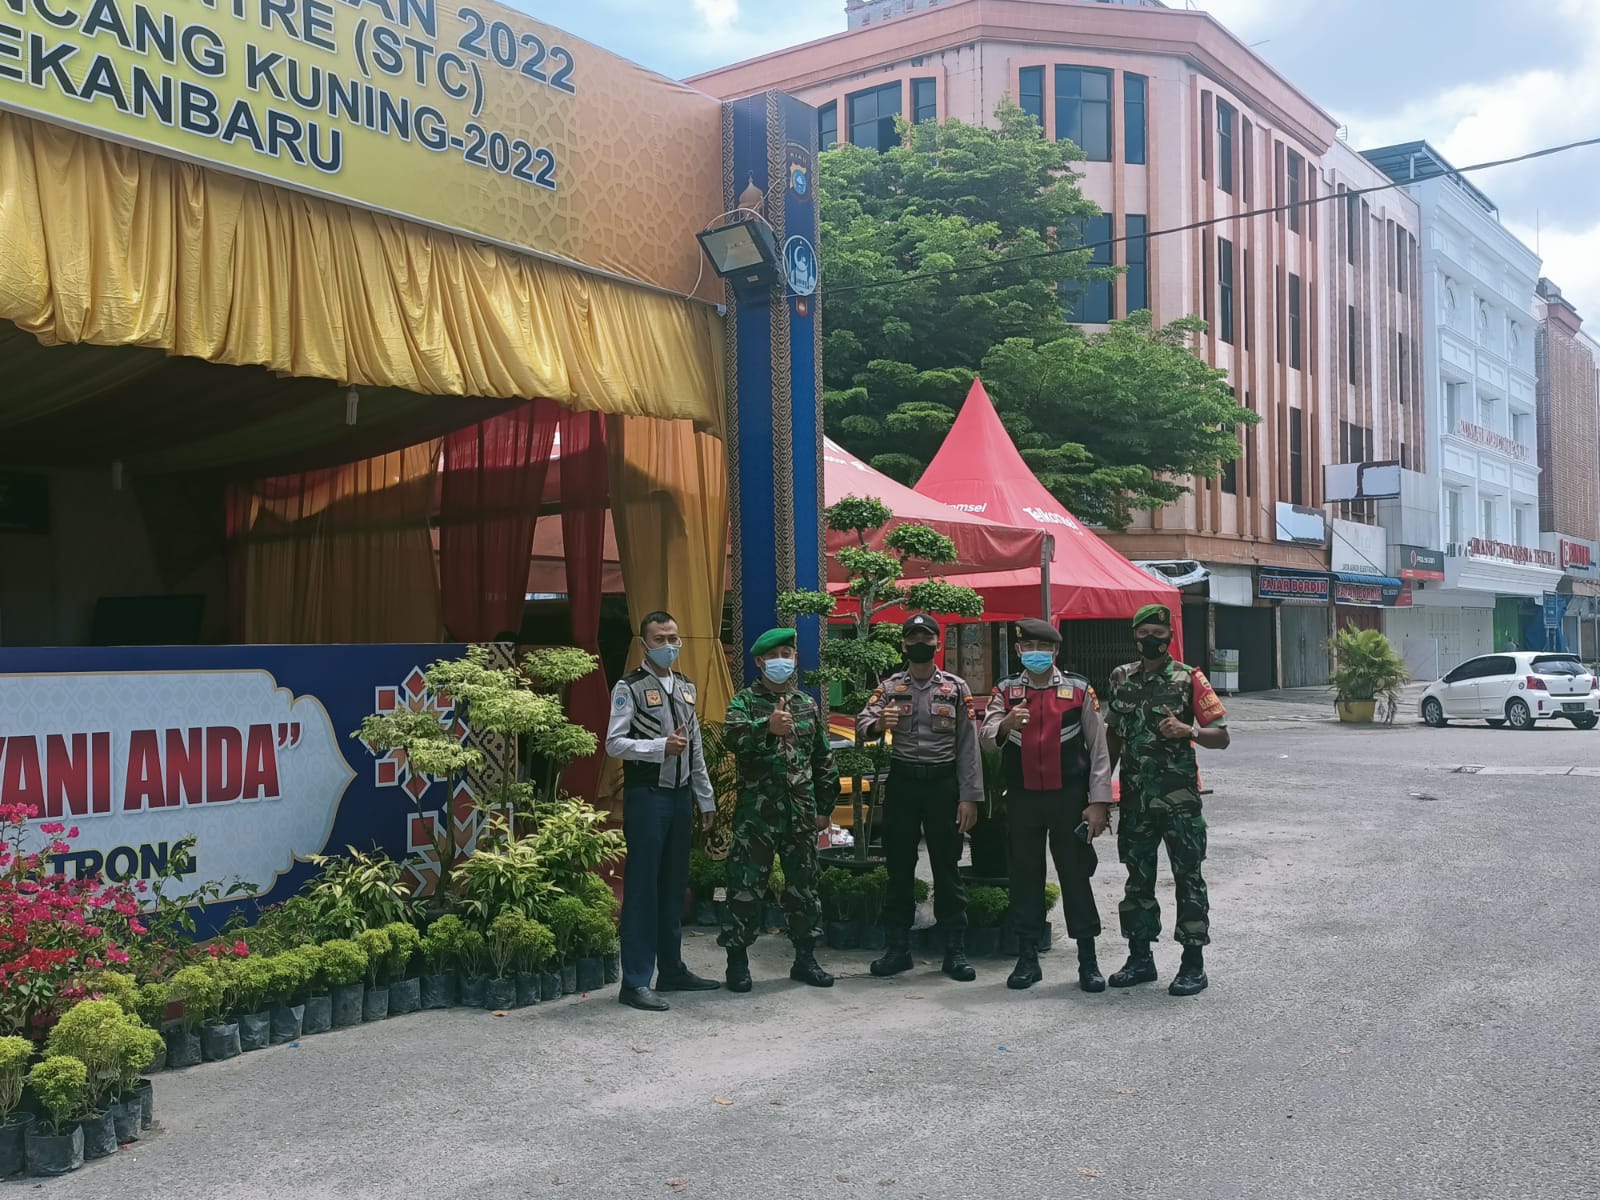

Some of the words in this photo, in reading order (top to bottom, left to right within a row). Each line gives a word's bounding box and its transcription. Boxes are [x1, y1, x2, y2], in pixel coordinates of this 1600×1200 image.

[0, 0, 227, 77] CANG
[246, 42, 556, 190] KUNING-2022
[354, 17, 484, 117] (STC)
[456, 6, 576, 95] 2022
[0, 22, 343, 174] EKANBARU
[1291, 579, 1327, 594] BORDIR
[0, 731, 111, 819] ANI
[16, 840, 197, 896] TRONG
